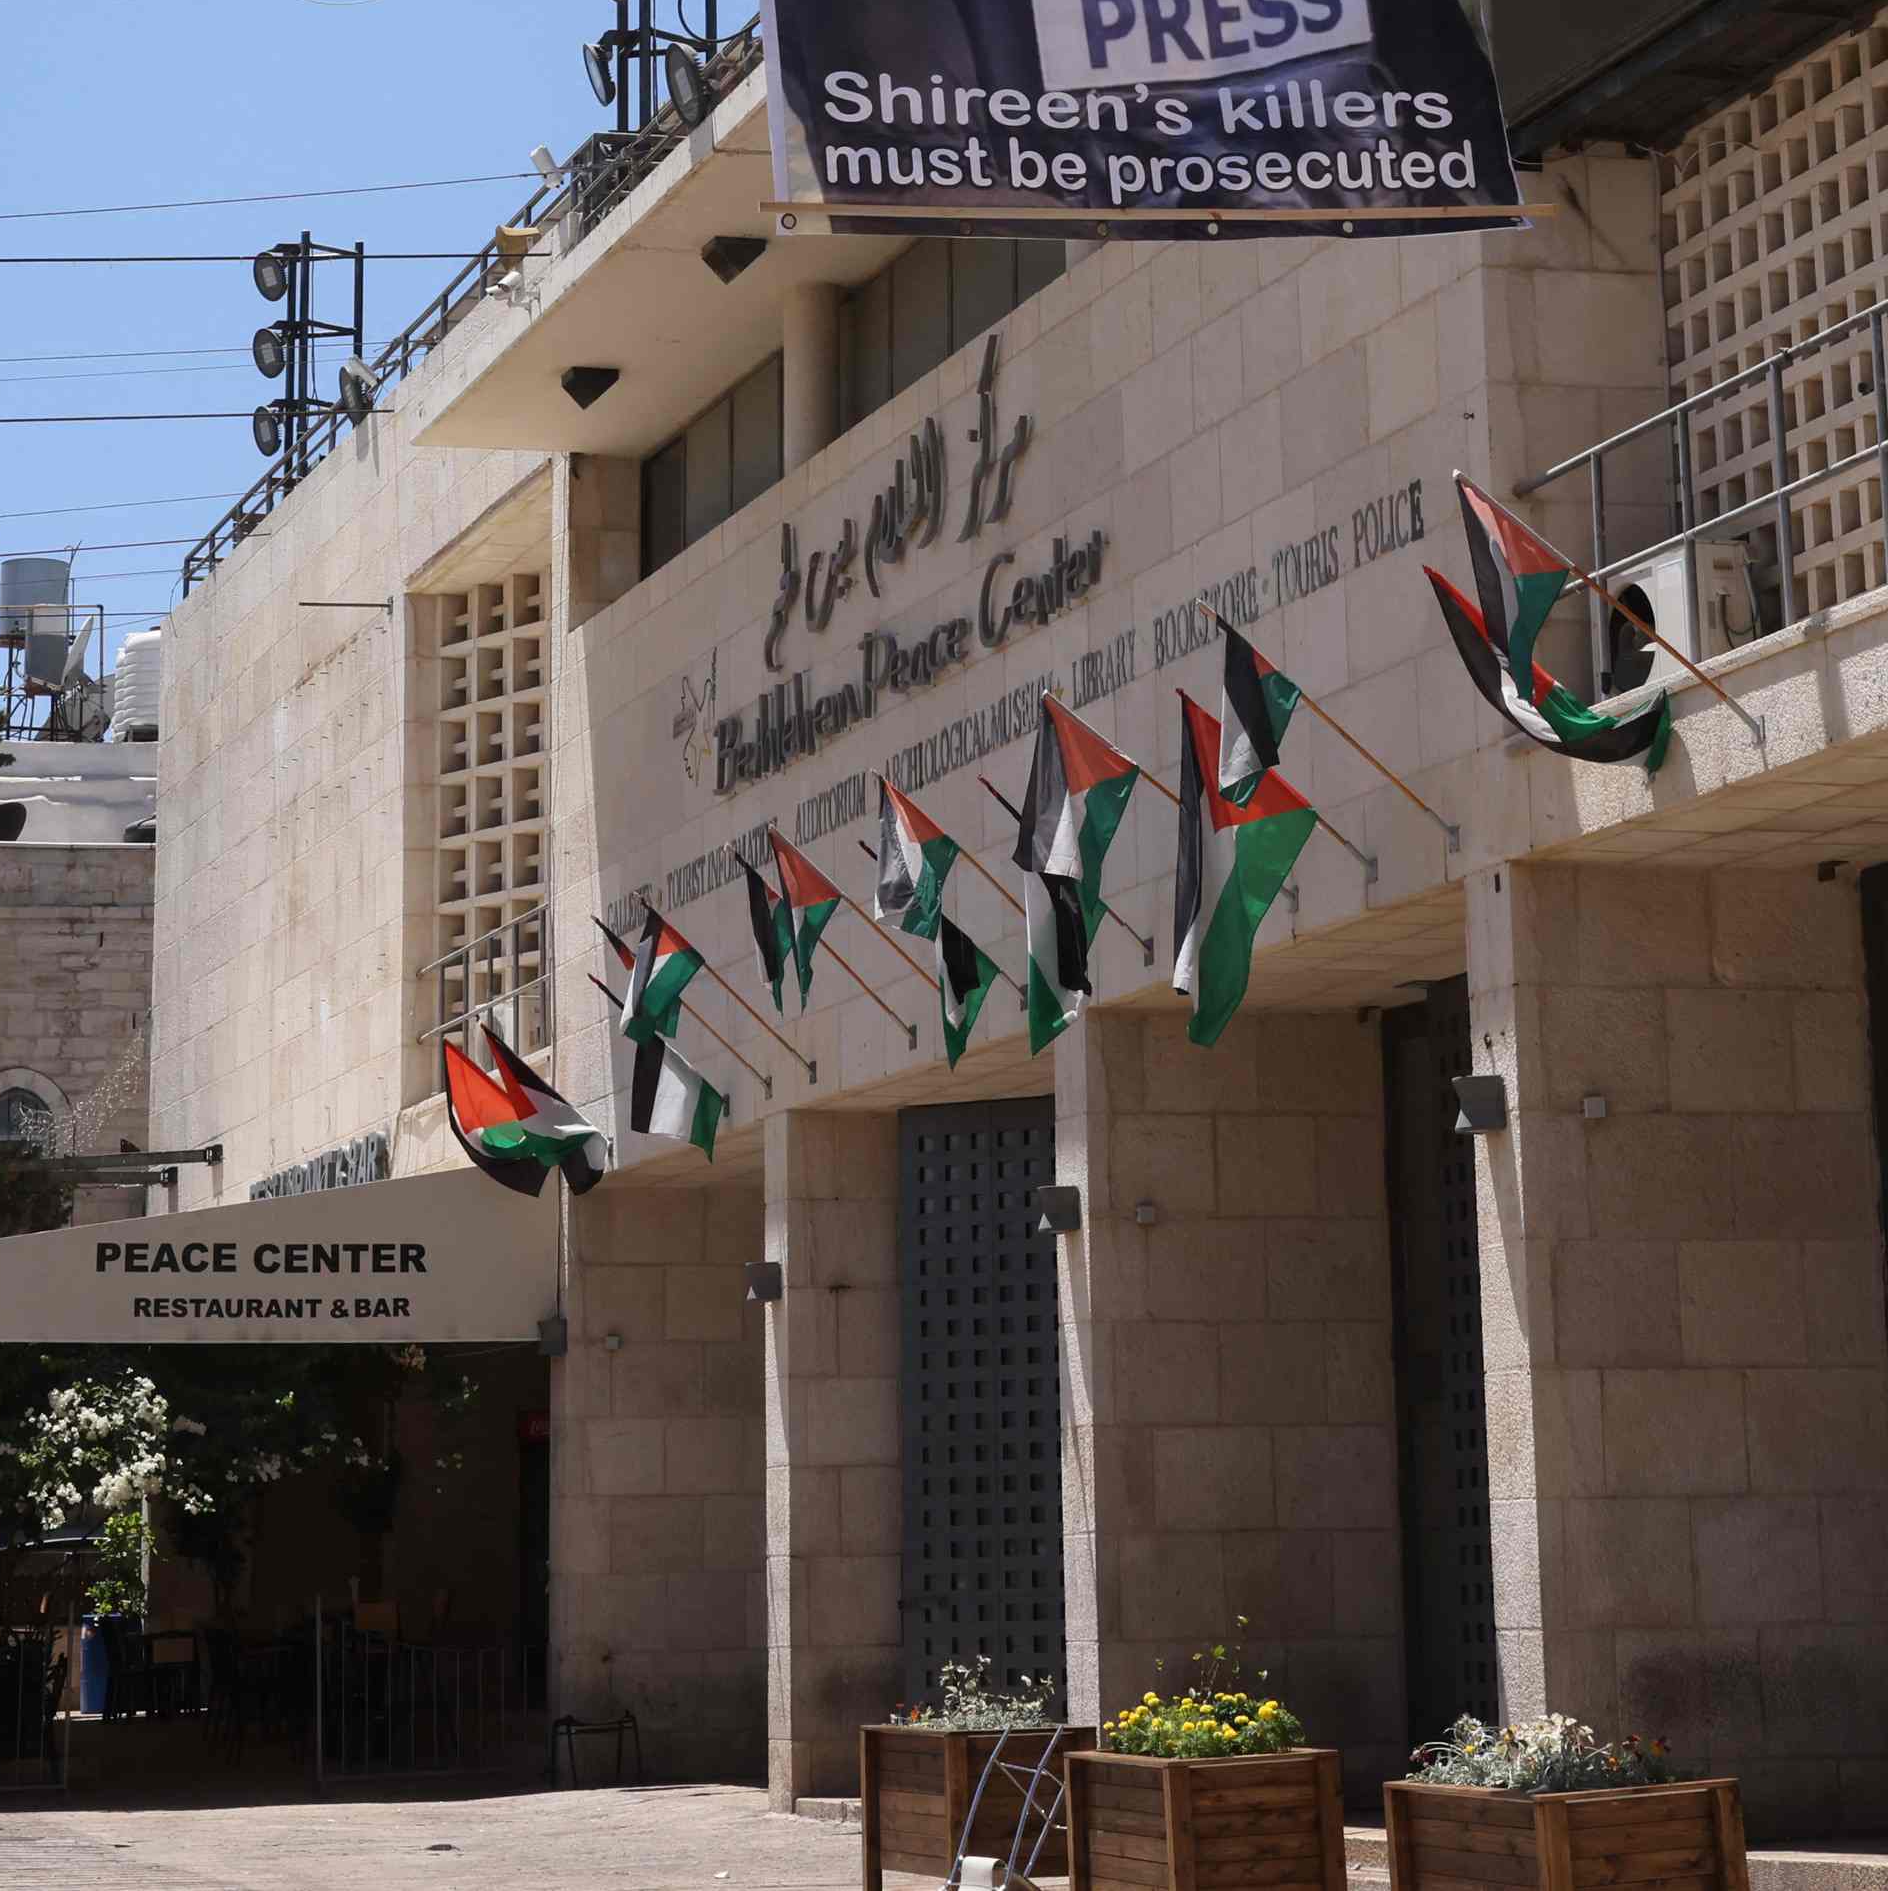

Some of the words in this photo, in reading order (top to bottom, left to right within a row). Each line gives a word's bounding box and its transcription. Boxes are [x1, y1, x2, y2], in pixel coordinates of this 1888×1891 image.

[1219, 79, 1454, 134] killers
[823, 137, 993, 189] must
[1008, 136, 1087, 190] be
[1108, 139, 1478, 206] prosecuted
[714, 667, 861, 796] Bethlehem
[858, 616, 974, 720] Peace
[978, 529, 1106, 649] Center
[794, 770, 867, 849] AUDITORIUM
[1071, 628, 1136, 710] LIBRARY
[1152, 565, 1260, 671] BOOKSTORE
[1352, 477, 1425, 569] POLICE
[95, 1242, 238, 1273] PEACE
[253, 1243, 428, 1274] CENTER
[133, 1297, 322, 1319] RESTAURANT
[329, 1298, 349, 1318] &
[354, 1297, 411, 1318] BAR
